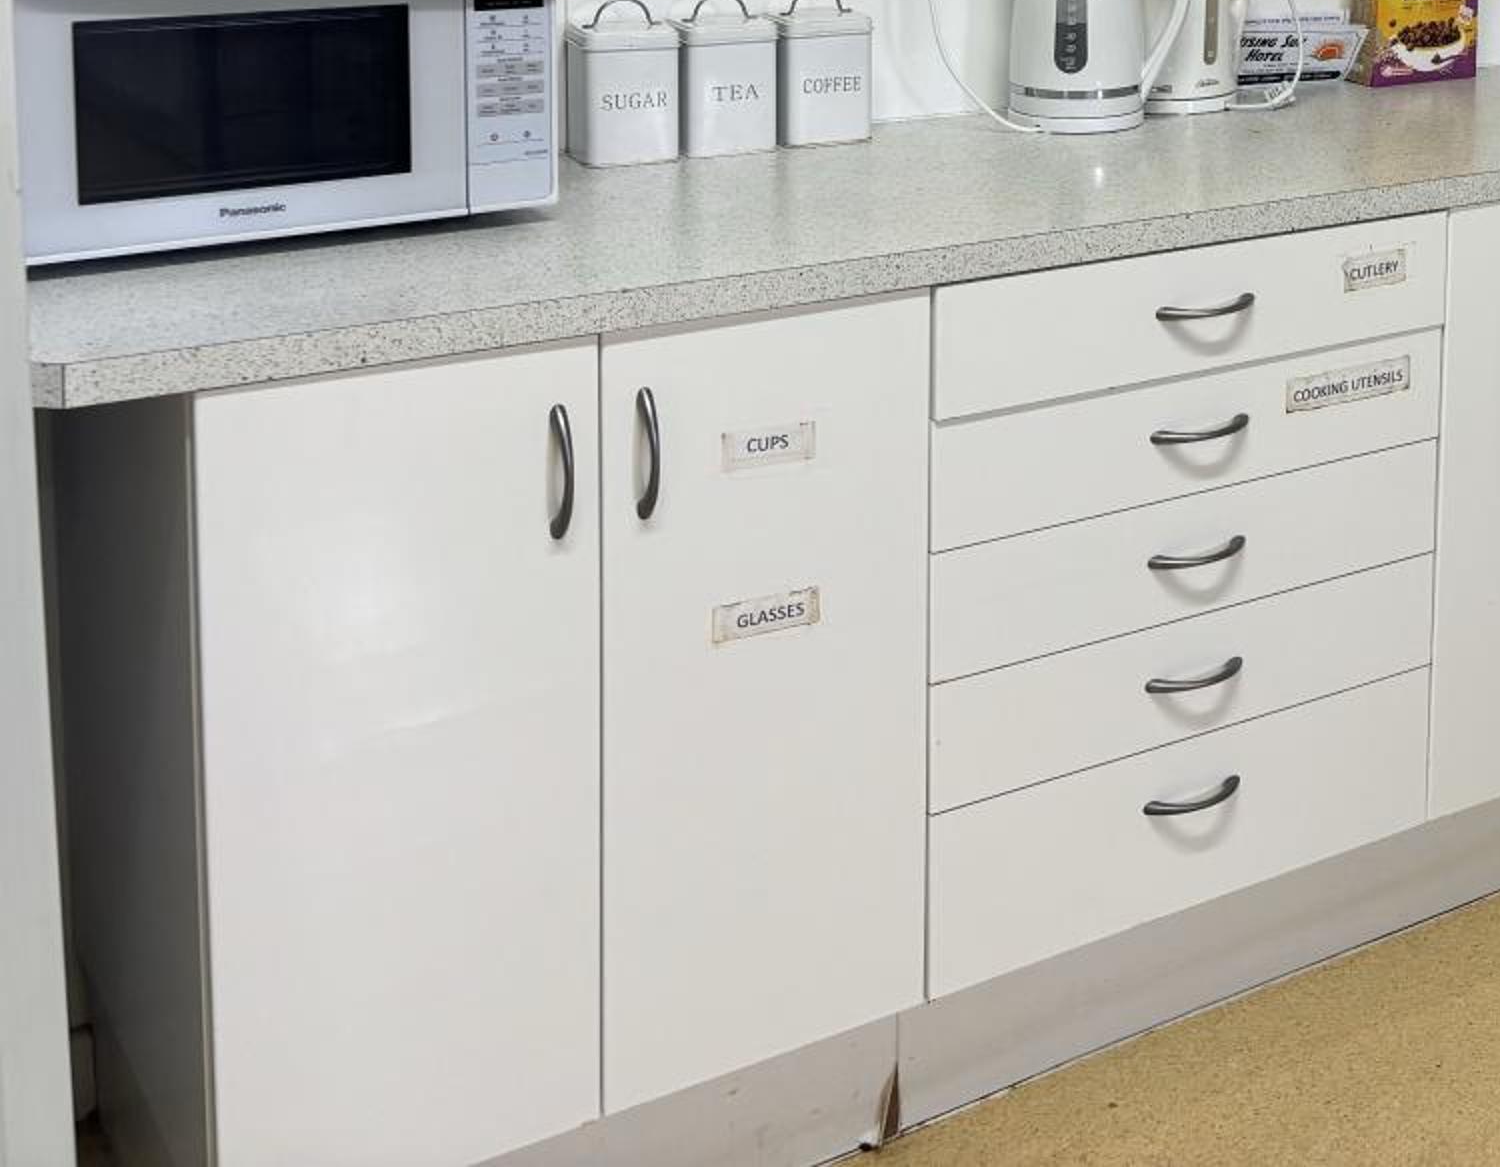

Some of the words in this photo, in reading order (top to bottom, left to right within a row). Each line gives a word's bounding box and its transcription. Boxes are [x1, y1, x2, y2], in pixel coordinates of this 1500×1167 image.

[712, 83, 760, 102] TEA
[803, 76, 862, 94] COFFEE
[602, 91, 667, 111] SUGAR
[219, 202, 286, 218] Panasonic
[1350, 260, 1398, 281] CUTLERY
[1293, 380, 1348, 403] COOKING
[1351, 368, 1403, 391] UTENSILS
[746, 434, 789, 453] CUPS
[737, 602, 805, 628] GLASSES
